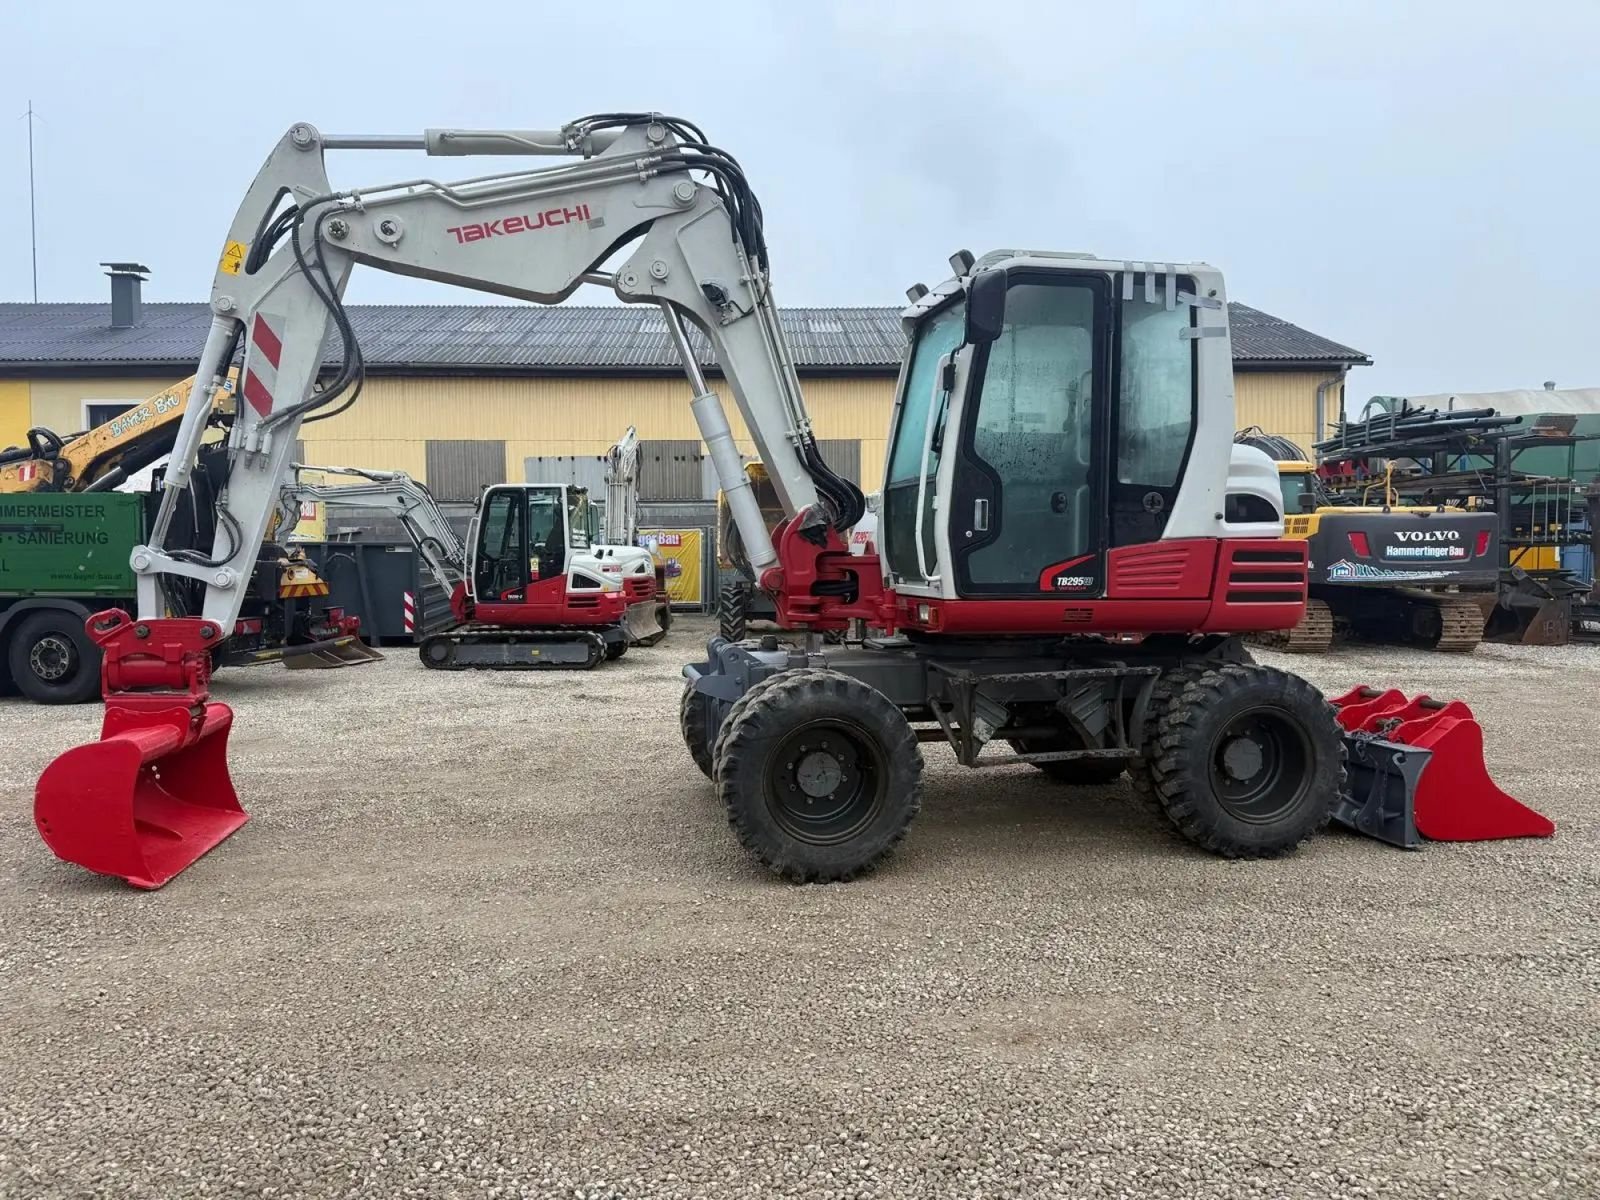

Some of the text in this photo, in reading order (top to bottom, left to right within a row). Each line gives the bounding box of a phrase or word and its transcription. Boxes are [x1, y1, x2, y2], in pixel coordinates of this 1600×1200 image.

[447, 204, 591, 244] TAKEUCHI
[154, 393, 181, 415] BAU
[0, 505, 105, 518] MERMEISTER
[17, 531, 109, 545] SANIERUNG
[659, 532, 680, 545] Bau
[1394, 530, 1460, 542] VOLVO
[1386, 545, 1464, 558] Hammertinger Bau
